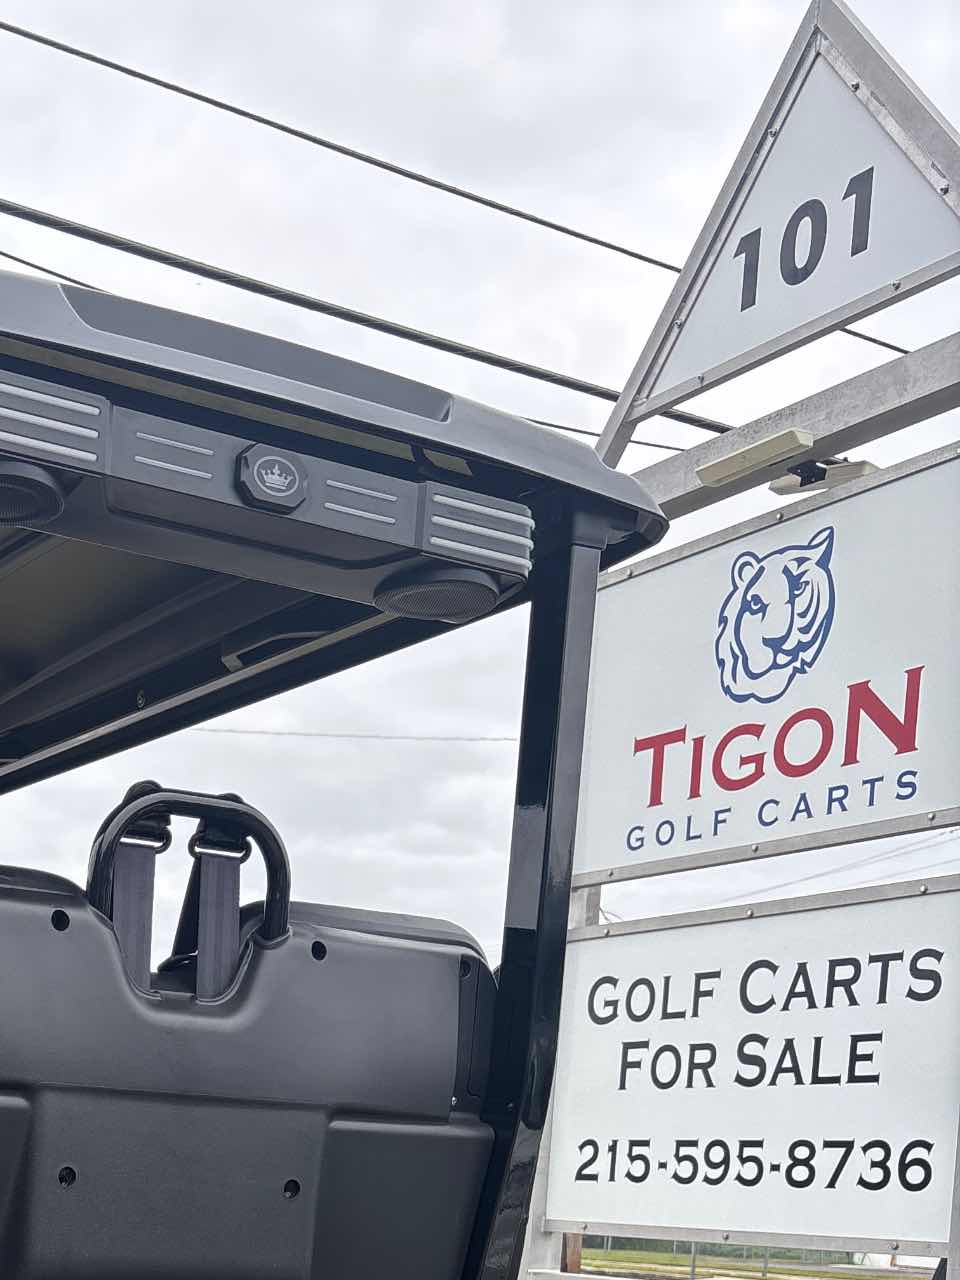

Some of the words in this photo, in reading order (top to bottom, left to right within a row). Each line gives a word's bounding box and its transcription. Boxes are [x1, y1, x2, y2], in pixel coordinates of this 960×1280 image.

[734, 165, 874, 313] 101
[633, 666, 926, 808] TIGON
[626, 807, 732, 851] GOLF
[757, 769, 918, 827] CARTS
[588, 968, 722, 1025] GOLF
[739, 948, 944, 1014] CARTS
[618, 1038, 716, 1090] FOR
[734, 1031, 883, 1088] SALE
[575, 1137, 935, 1192] 215-595-8736
